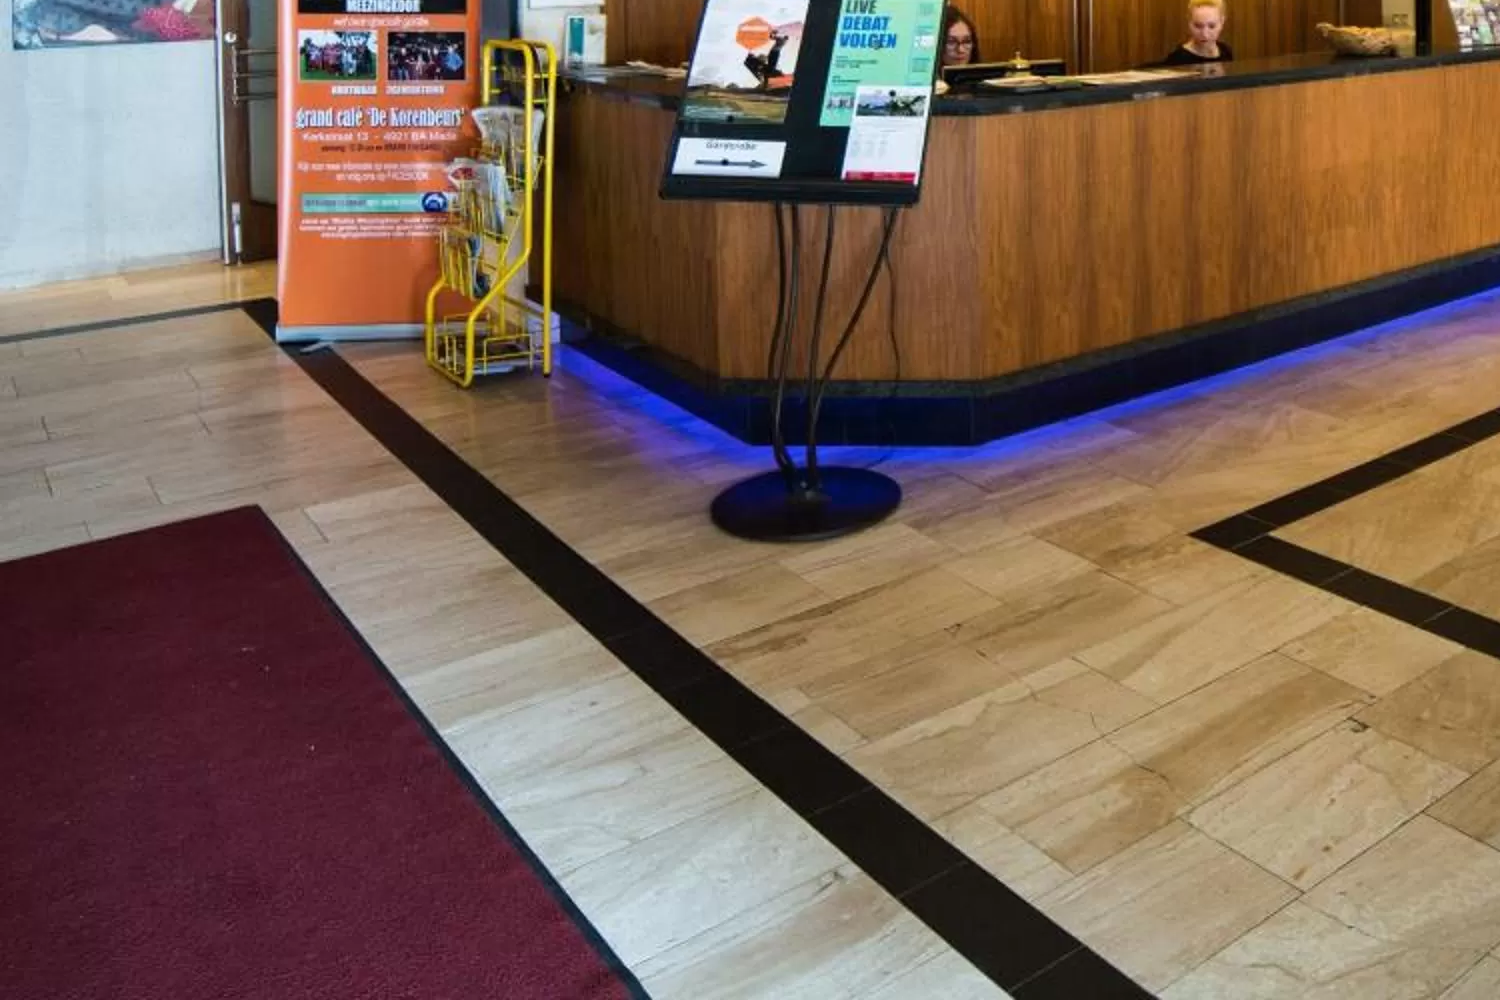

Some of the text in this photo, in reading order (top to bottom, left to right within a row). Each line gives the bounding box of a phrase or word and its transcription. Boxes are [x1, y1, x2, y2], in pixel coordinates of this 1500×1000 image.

[845, 0, 878, 14] LIVE
[842, 16, 891, 31] DEBAT
[839, 33, 897, 49] VOLGEN
[296, 108, 333, 129] grand
